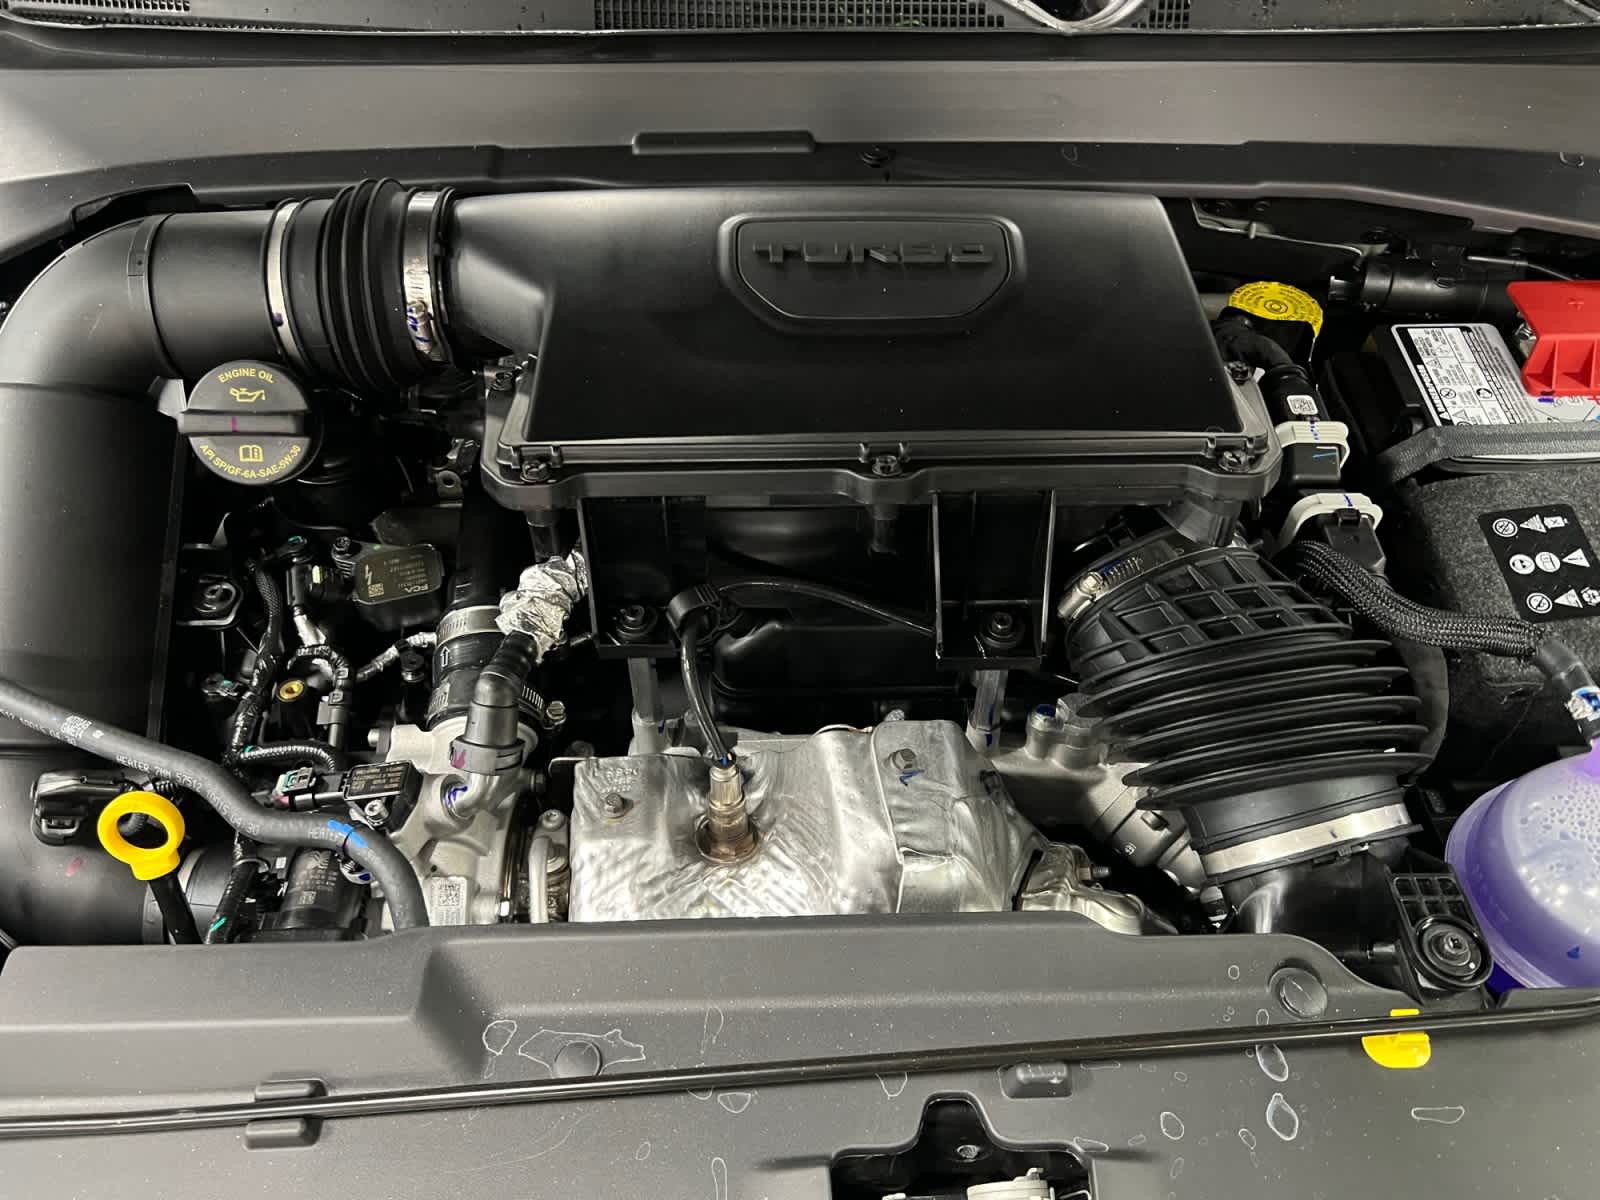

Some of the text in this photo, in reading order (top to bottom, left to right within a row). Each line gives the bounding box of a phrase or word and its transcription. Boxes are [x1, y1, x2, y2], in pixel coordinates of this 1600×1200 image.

[752, 240, 994, 264] TURBO
[218, 367, 274, 384] ENGINE OIL
[200, 444, 217, 461] API
[404, 583, 429, 593] FCA
[115, 754, 150, 772] HEATER
